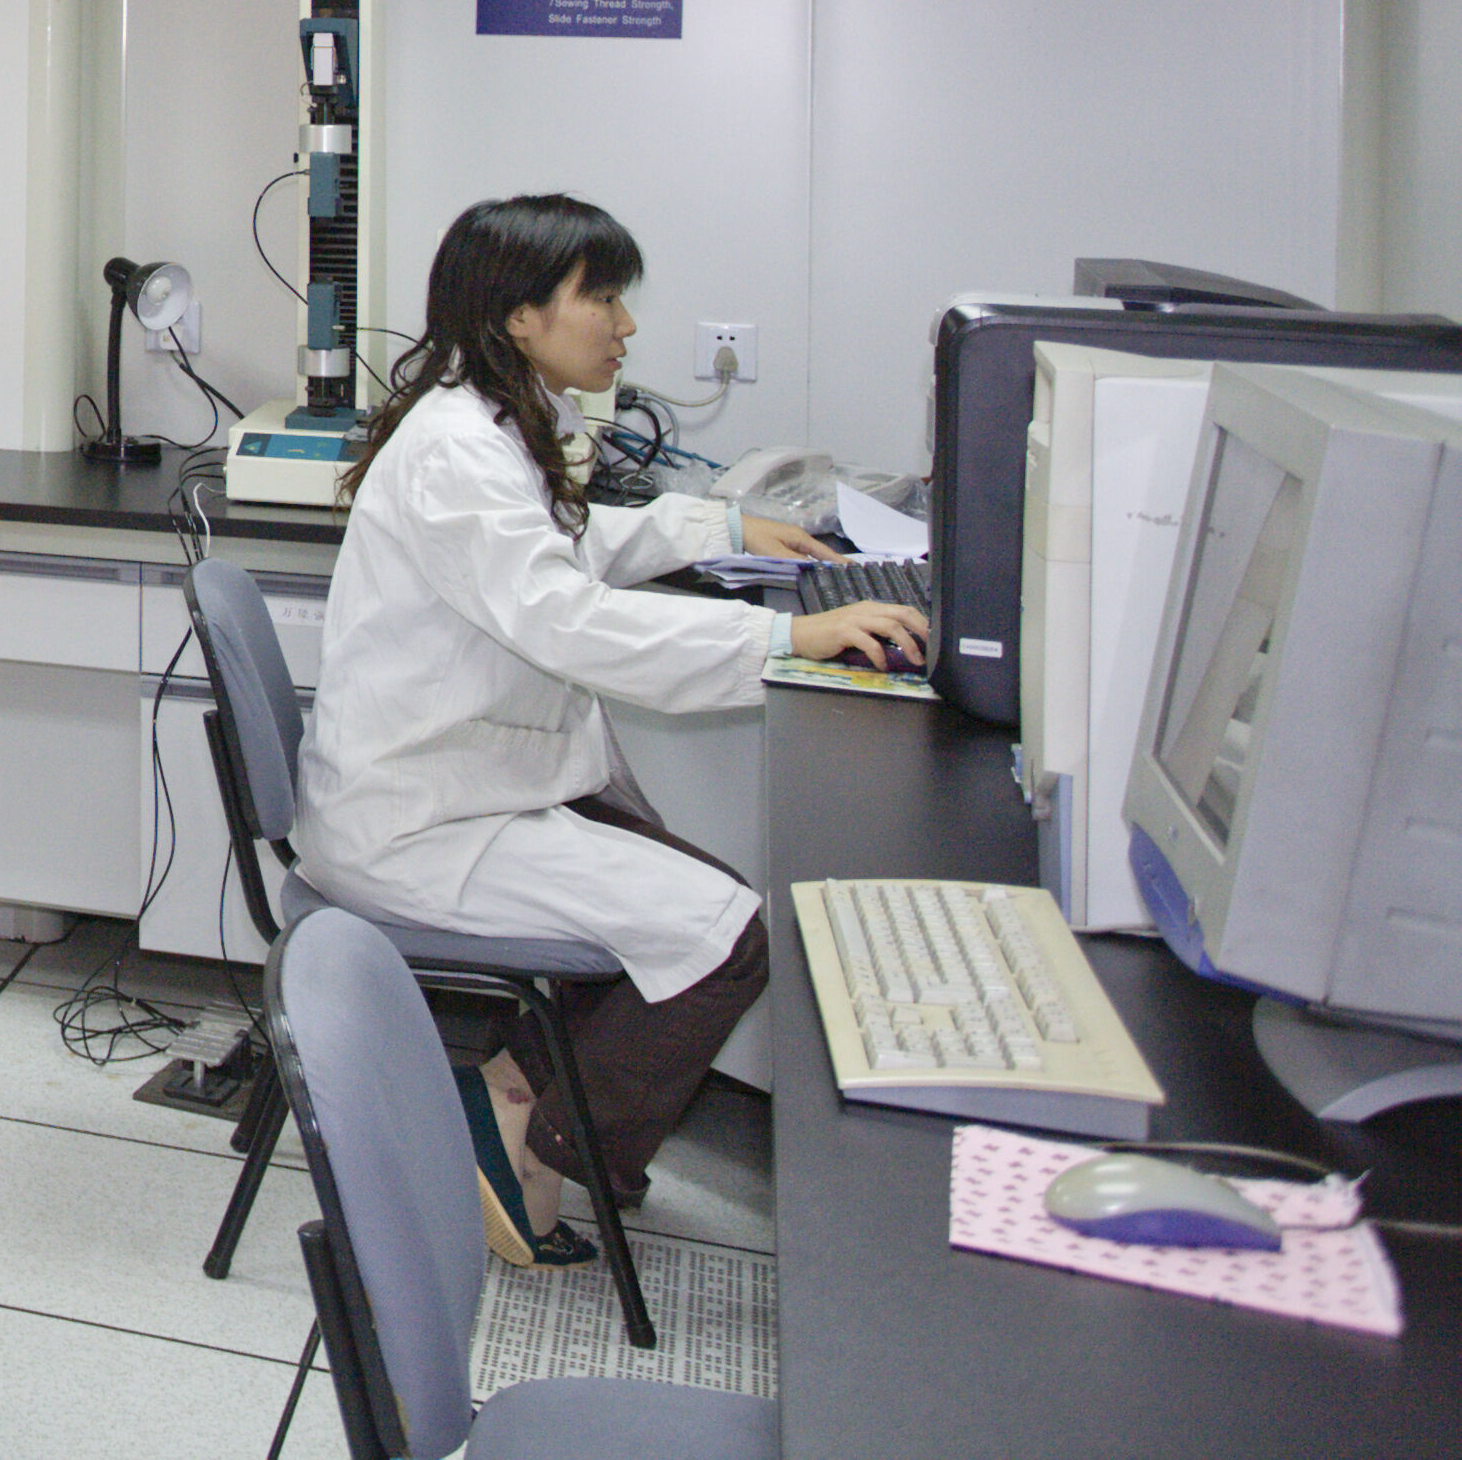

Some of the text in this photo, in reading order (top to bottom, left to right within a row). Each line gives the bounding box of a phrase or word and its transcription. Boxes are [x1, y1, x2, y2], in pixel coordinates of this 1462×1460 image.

[594, 0, 626, 9] Thread
[548, 15, 661, 27] Slide Fastener Strength
